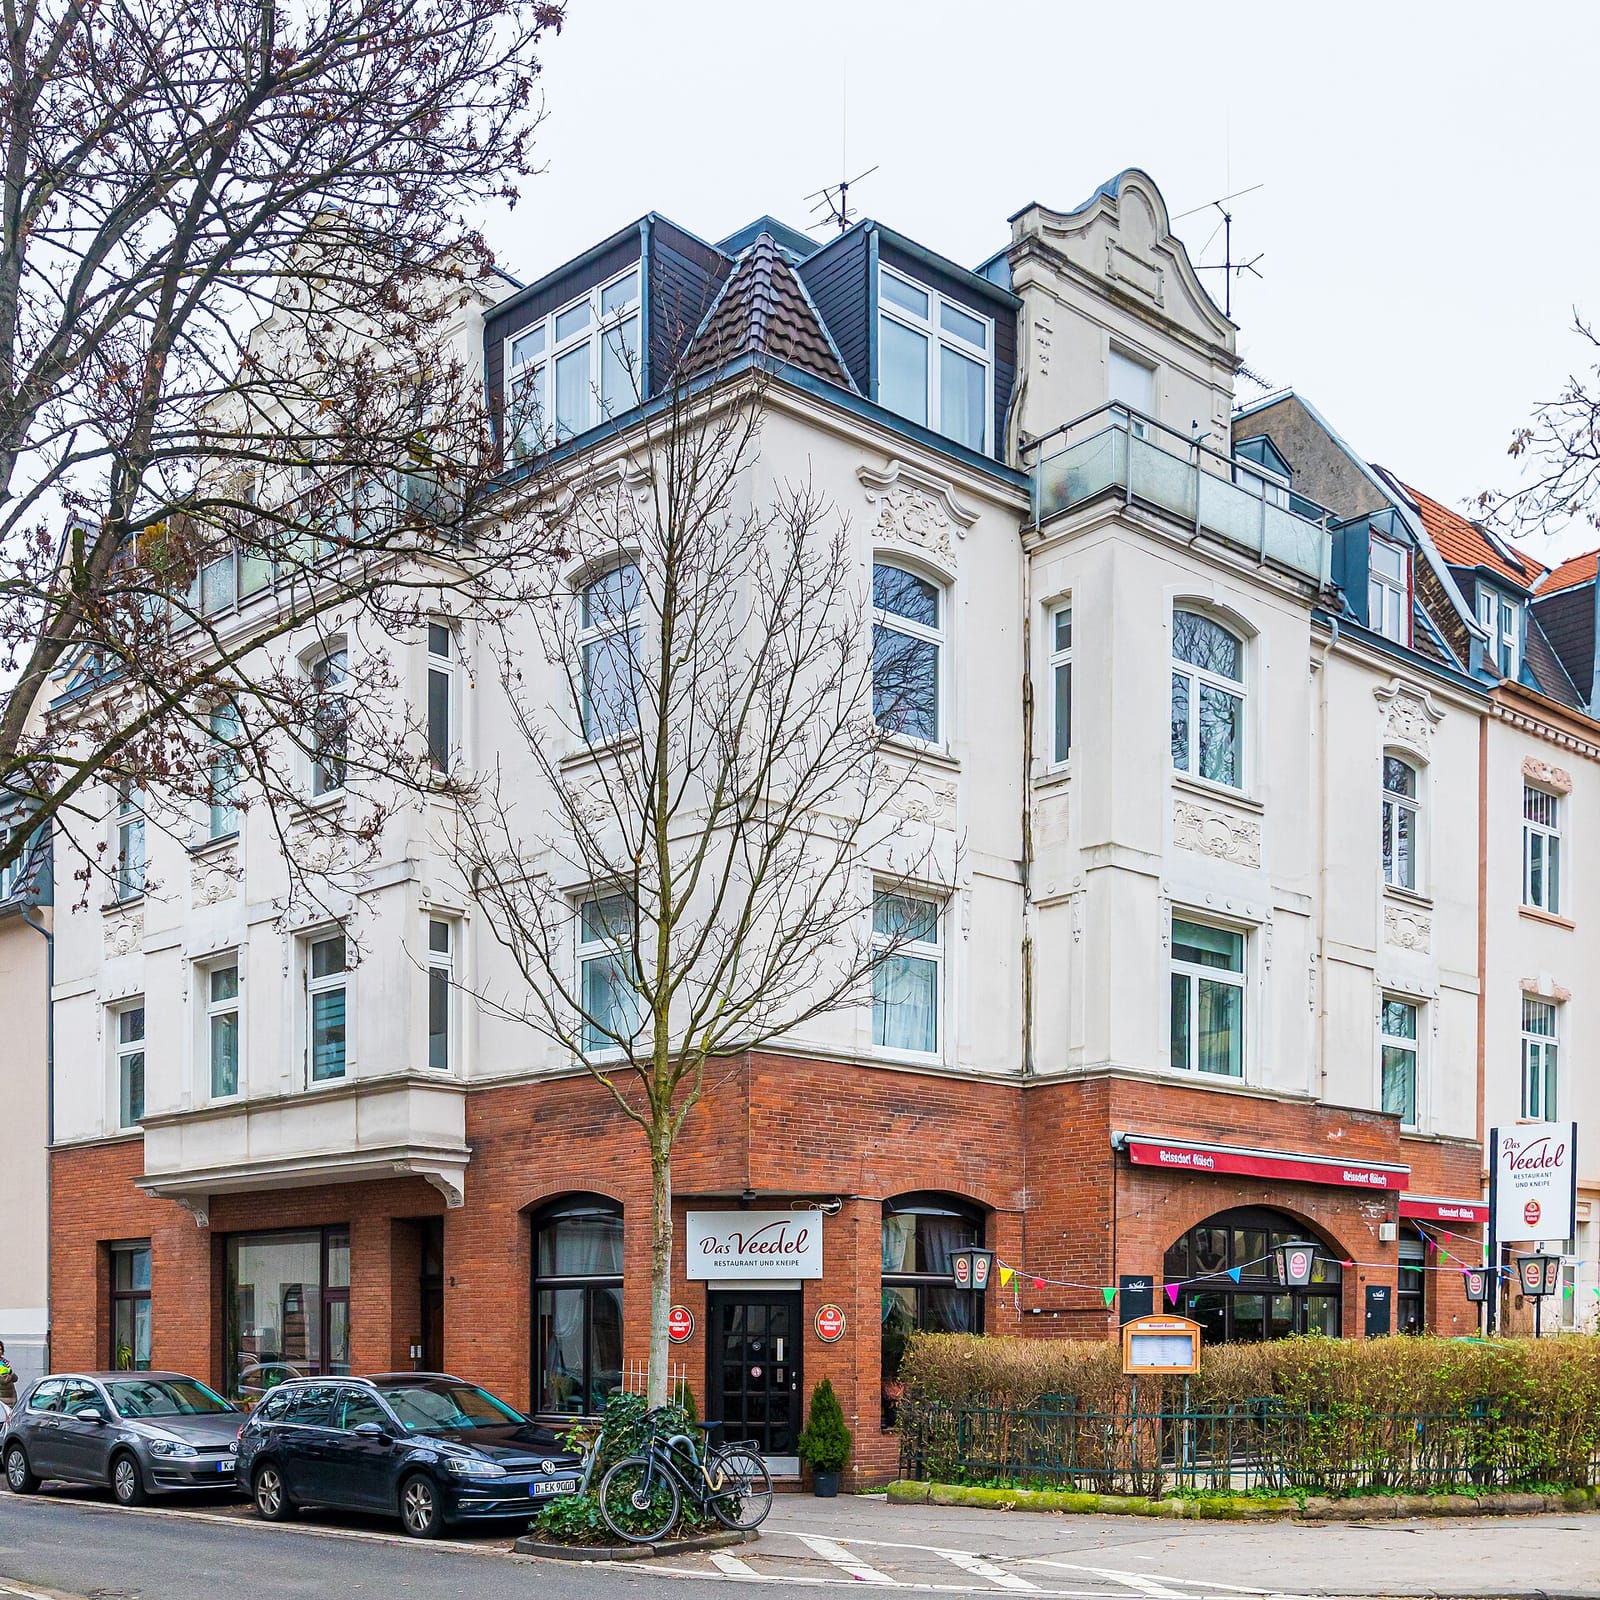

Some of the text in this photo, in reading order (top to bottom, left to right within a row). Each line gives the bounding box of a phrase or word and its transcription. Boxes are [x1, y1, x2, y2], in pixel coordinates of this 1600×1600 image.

[1503, 1137, 1521, 1150] Das
[1502, 1136, 1565, 1171] Veedel
[1513, 1171, 1553, 1180] RESTAURANT
[1515, 1180, 1551, 1189] UND KNEIPE
[699, 1220, 809, 1254] Das Veedel
[775, 1259, 800, 1267] KNEIPE
